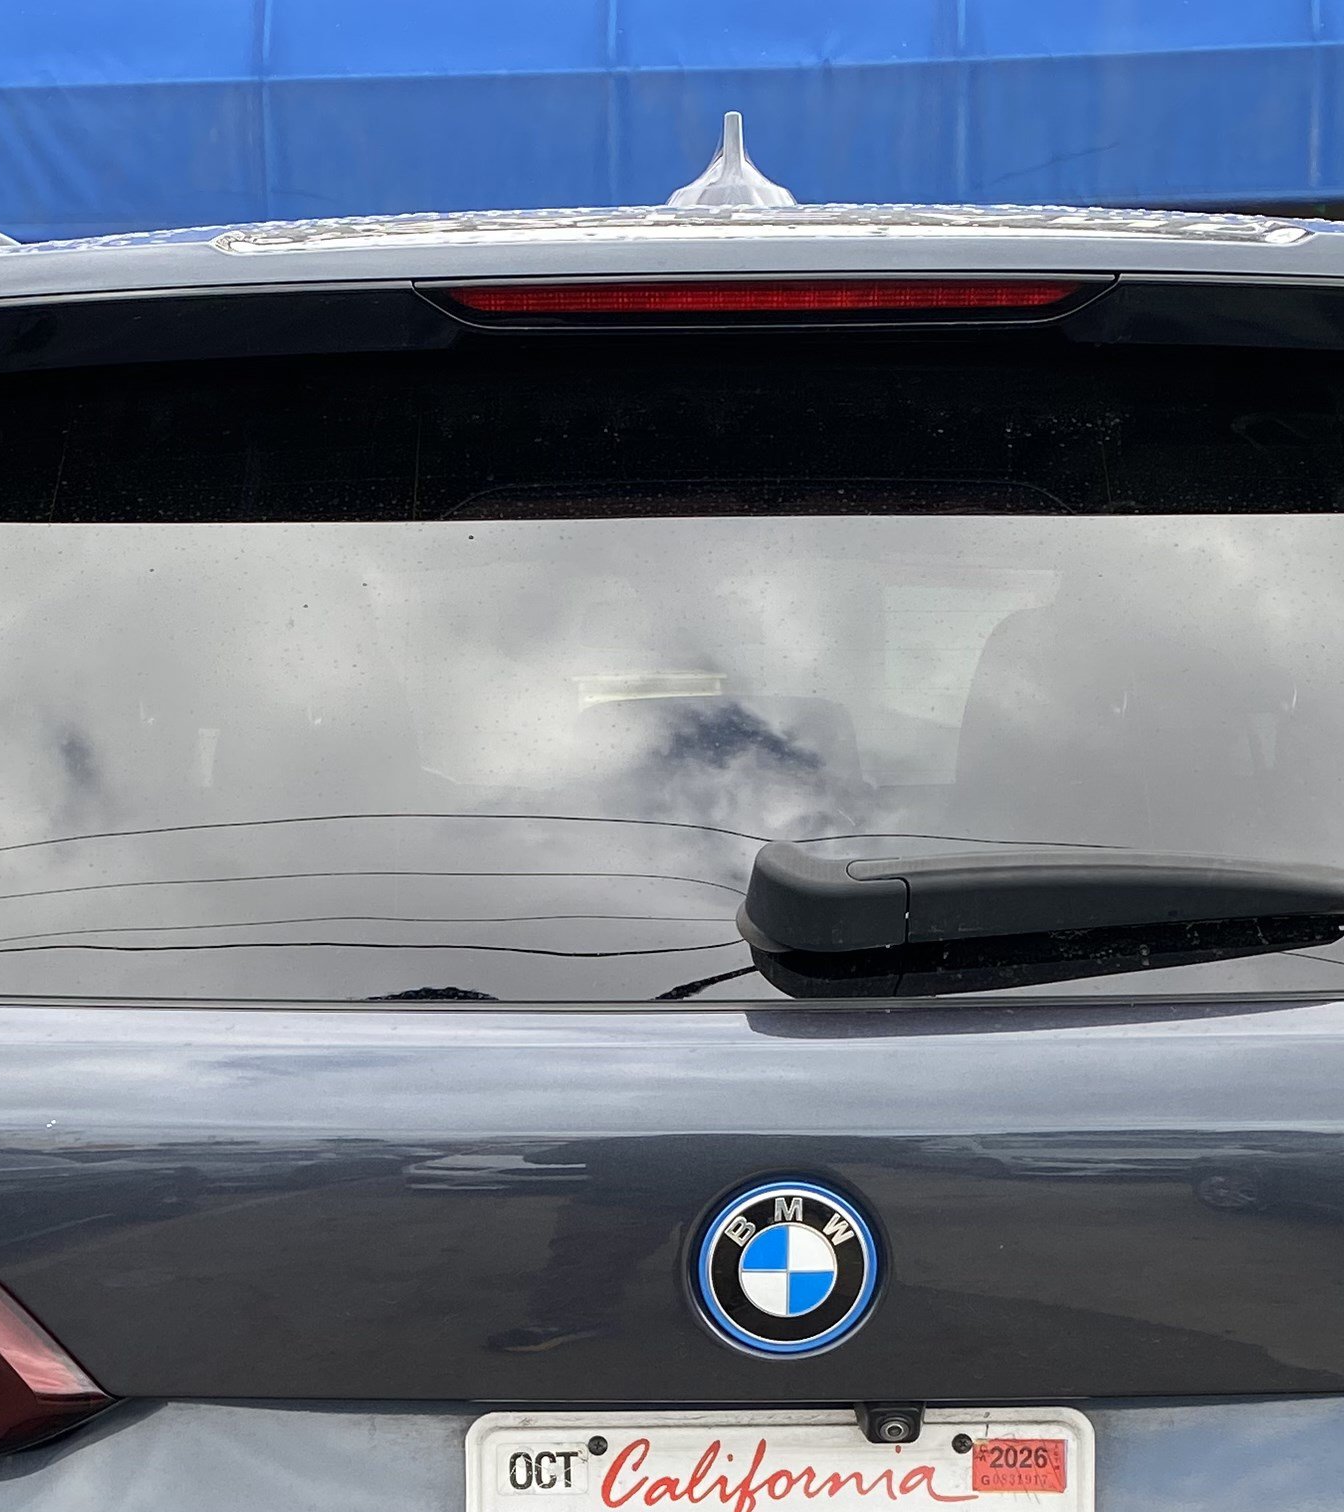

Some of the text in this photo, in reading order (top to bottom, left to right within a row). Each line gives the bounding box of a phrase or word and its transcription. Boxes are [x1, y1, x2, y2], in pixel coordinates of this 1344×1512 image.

[724, 1197, 855, 1248] BMW
[509, 1451, 579, 1490] OCT
[989, 1446, 1048, 1469] 2026
